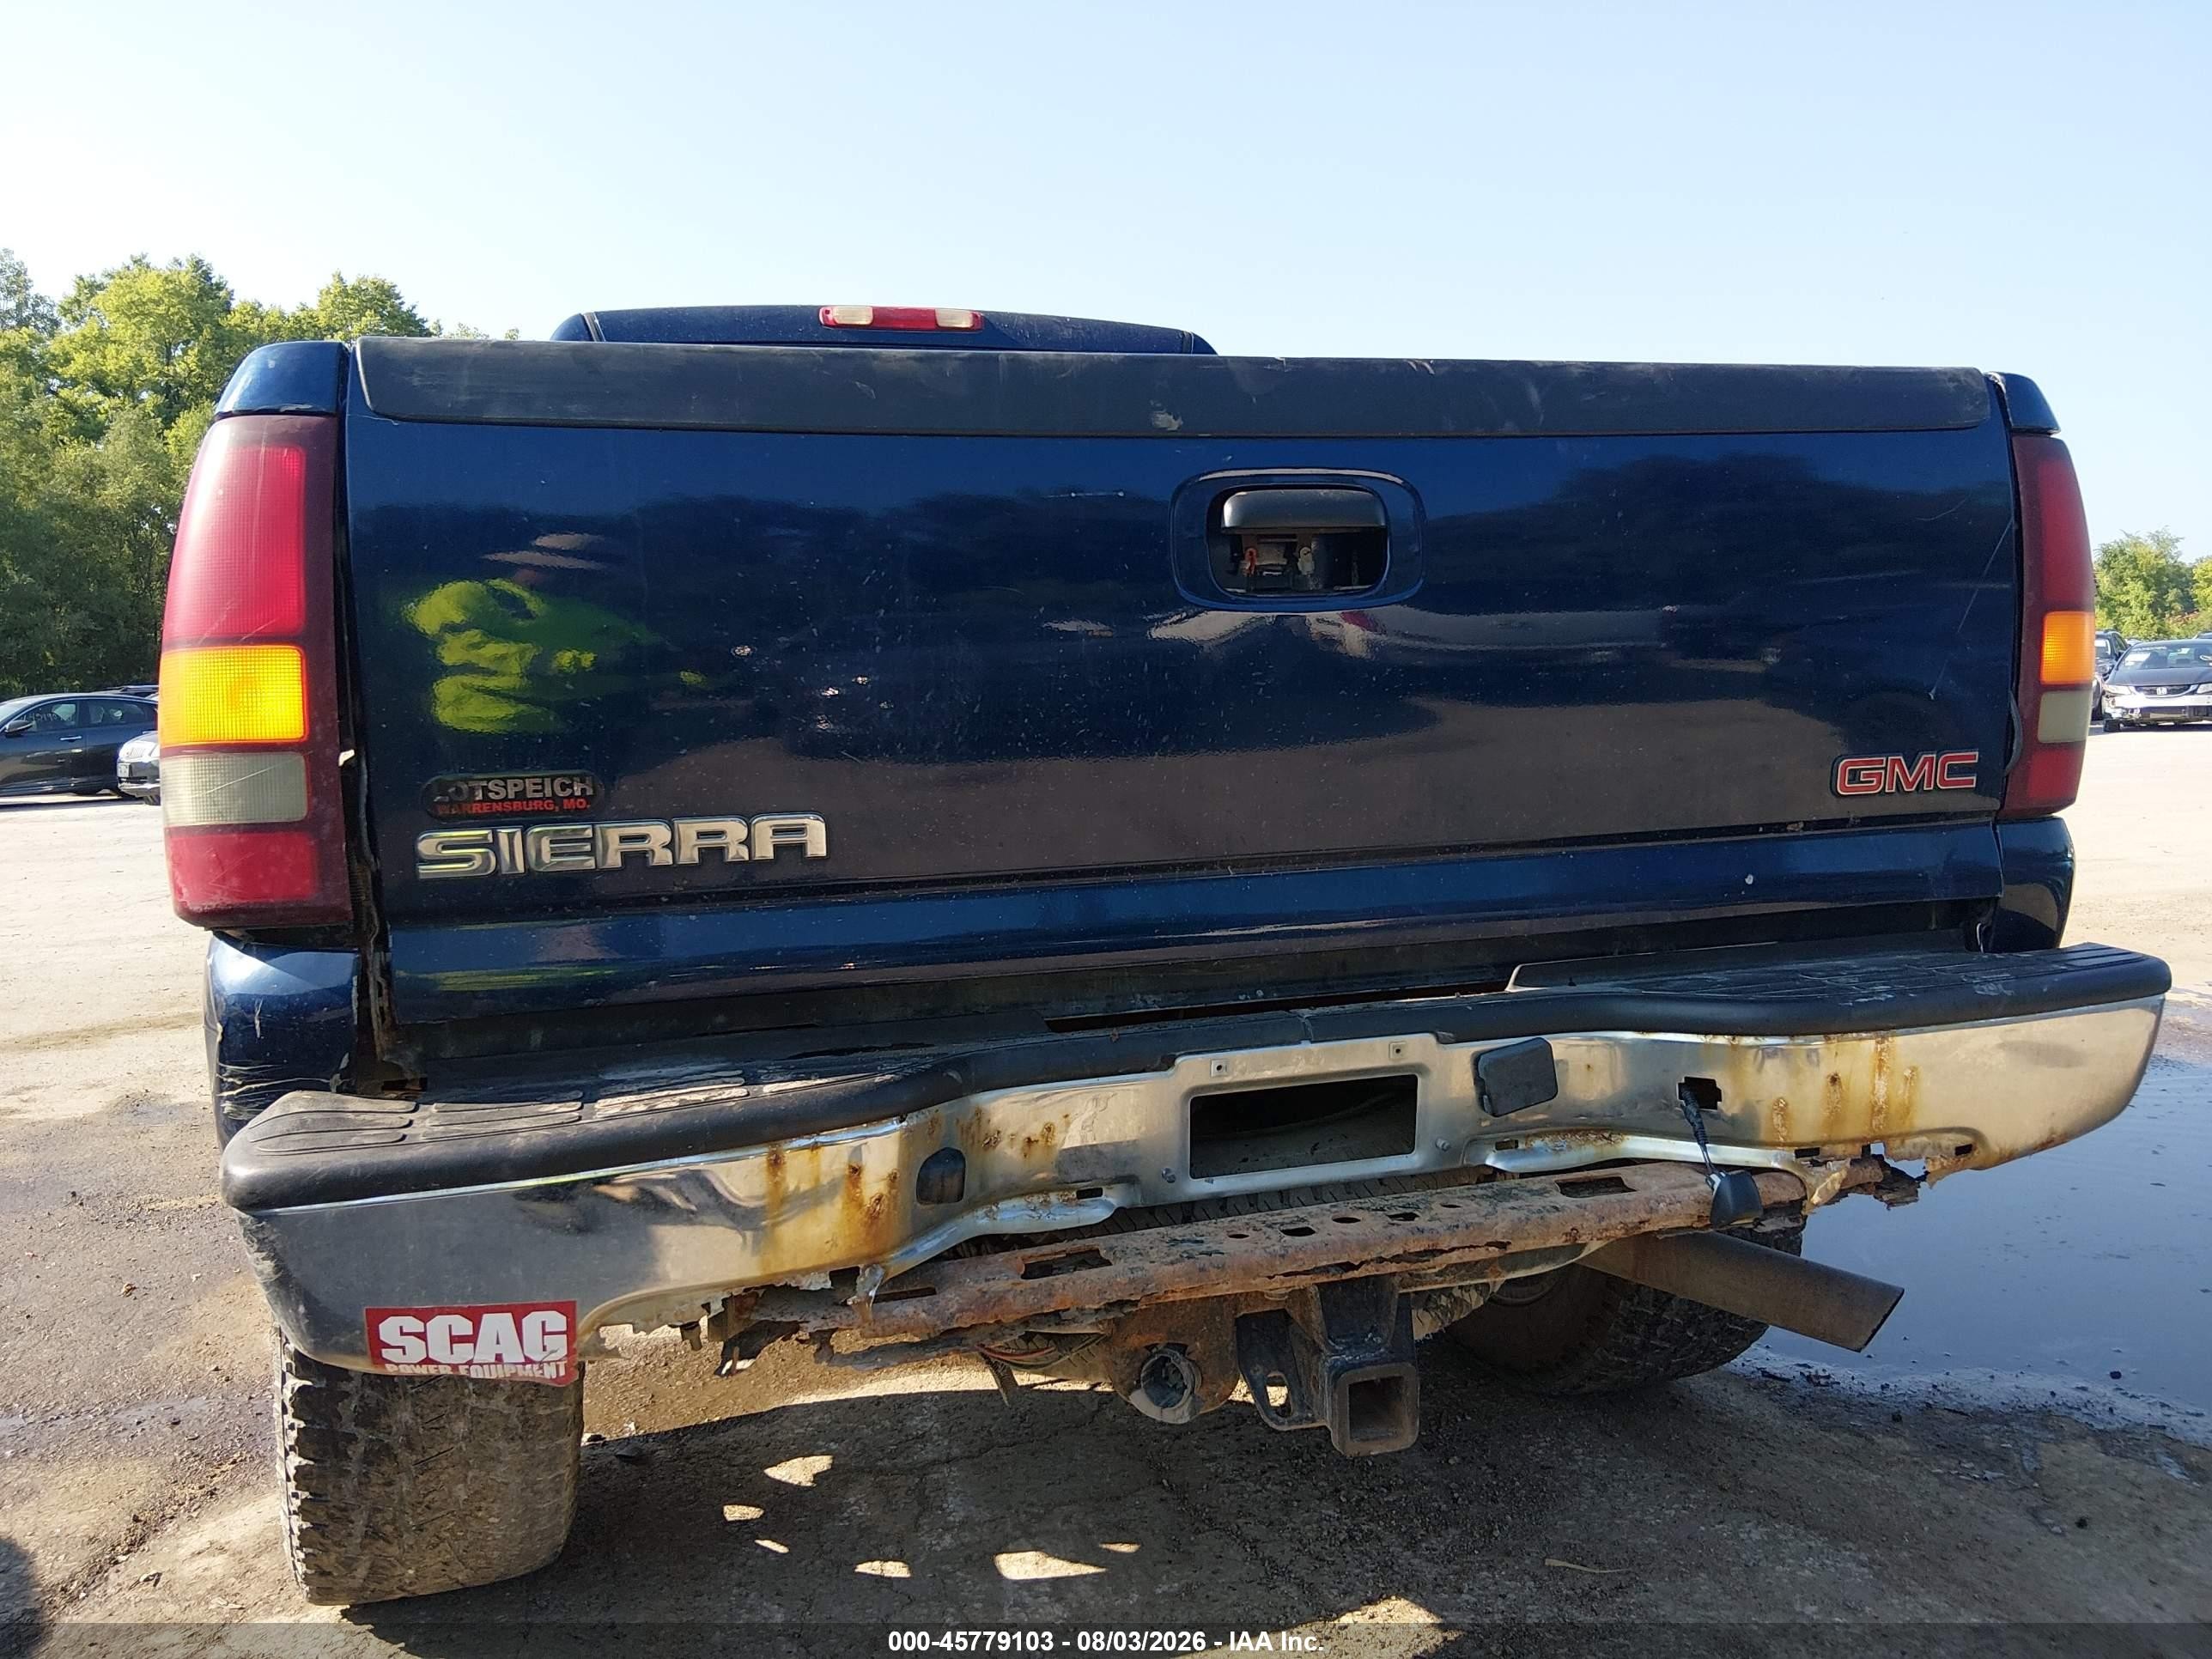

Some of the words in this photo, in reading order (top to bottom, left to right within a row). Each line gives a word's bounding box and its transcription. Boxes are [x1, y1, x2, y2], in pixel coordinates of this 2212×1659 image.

[1836, 751, 1979, 795] GMC
[563, 798, 592, 810] MO.
[416, 812, 827, 879] SIERRA
[378, 1310, 568, 1364] SCAG
